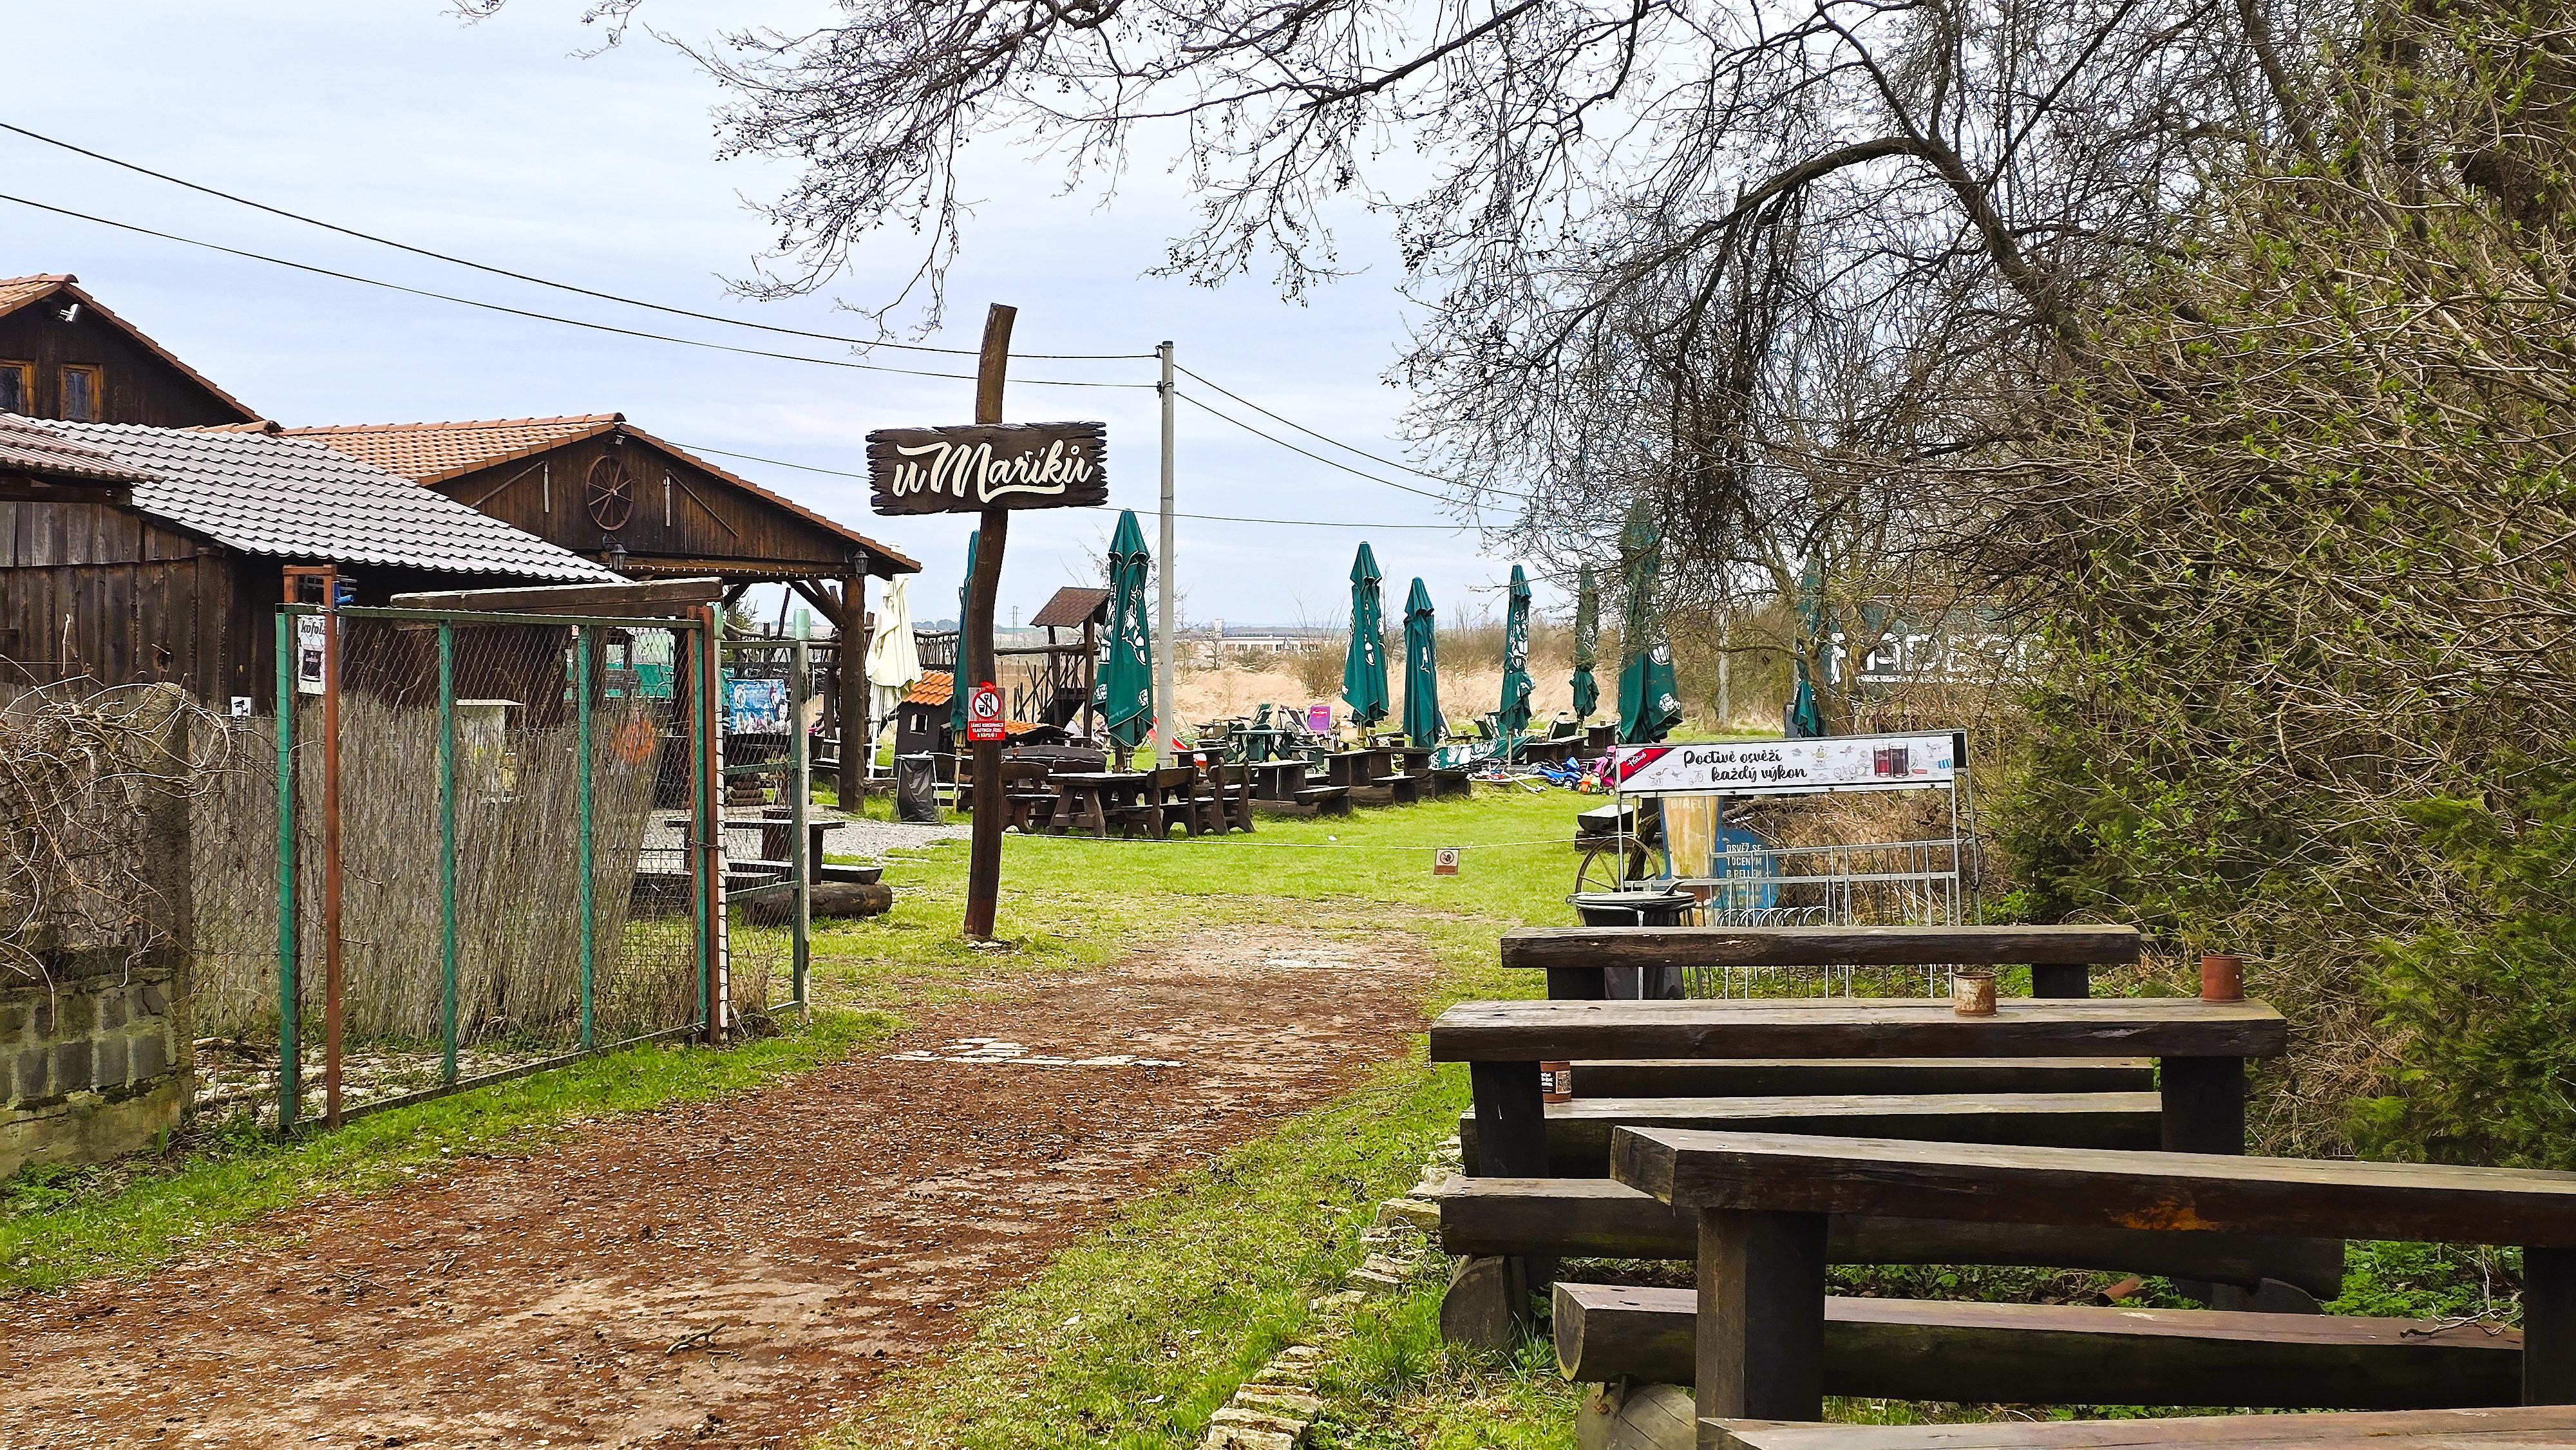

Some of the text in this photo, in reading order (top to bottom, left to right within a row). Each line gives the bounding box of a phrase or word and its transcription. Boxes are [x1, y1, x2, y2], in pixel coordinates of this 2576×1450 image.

[896, 439, 1094, 504] Mariků
[1683, 749, 1783, 768] Poctivě osvěží
[1711, 764, 1808, 783] každý výkon
